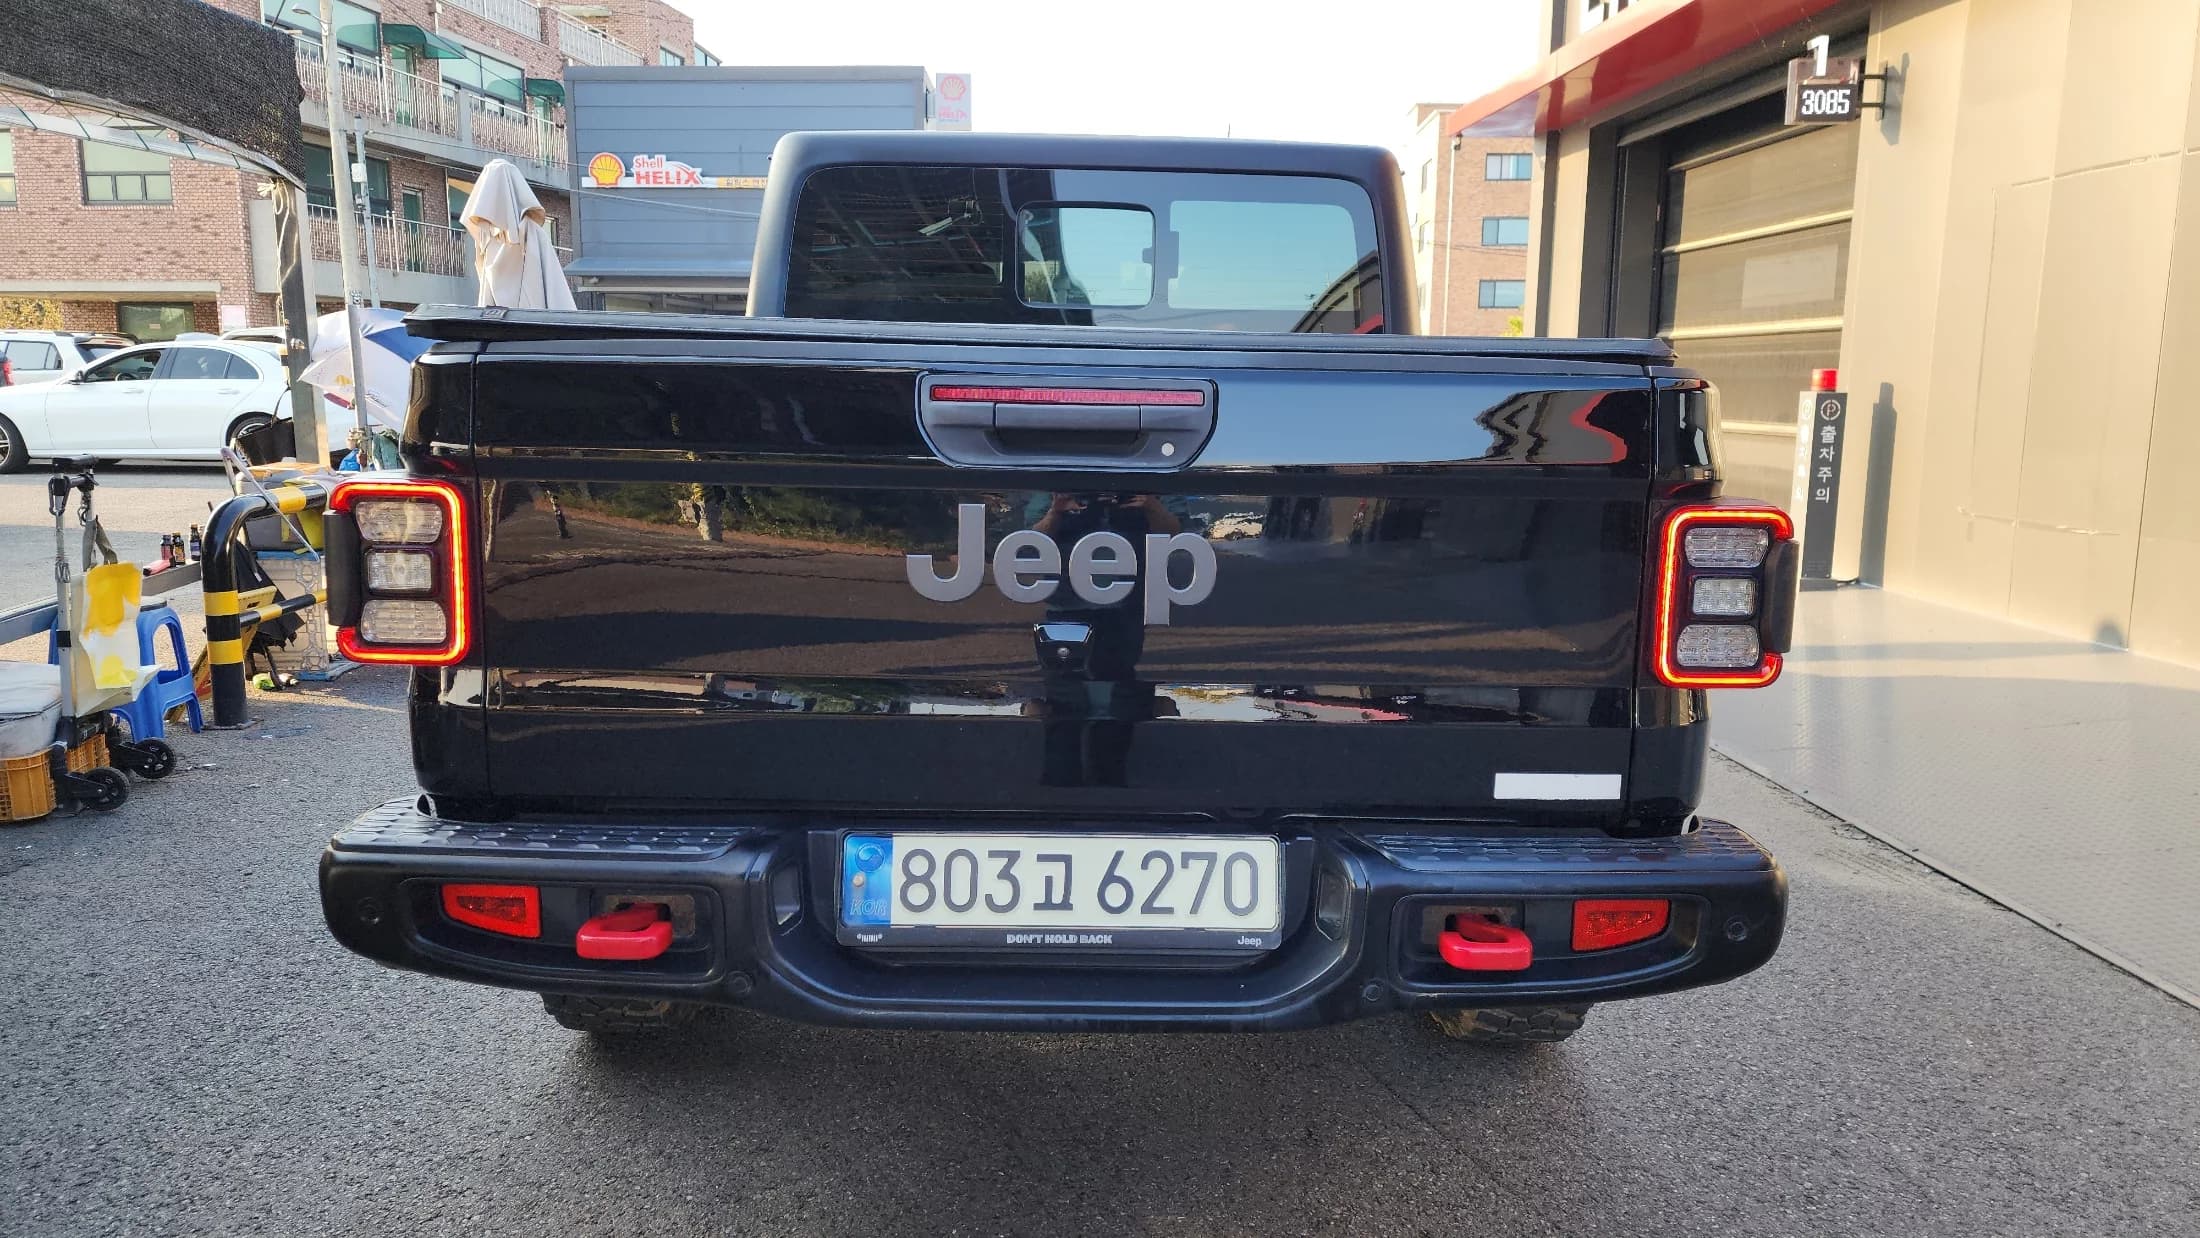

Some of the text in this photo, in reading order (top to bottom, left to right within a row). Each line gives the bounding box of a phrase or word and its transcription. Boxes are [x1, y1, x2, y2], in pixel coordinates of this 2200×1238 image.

[1807, 34, 1830, 77] 1
[1801, 89, 1851, 115] 3085
[635, 156, 663, 169] Shell
[635, 170, 702, 185] HELIX
[1815, 425, 1837, 504] 출차주의
[906, 503, 1217, 626] Jeep
[899, 848, 1259, 916] 803고 6270
[849, 899, 887, 916] KOR
[1006, 934, 1113, 944] DON'T HOLD BACK
[1237, 935, 1262, 948] Jeep
